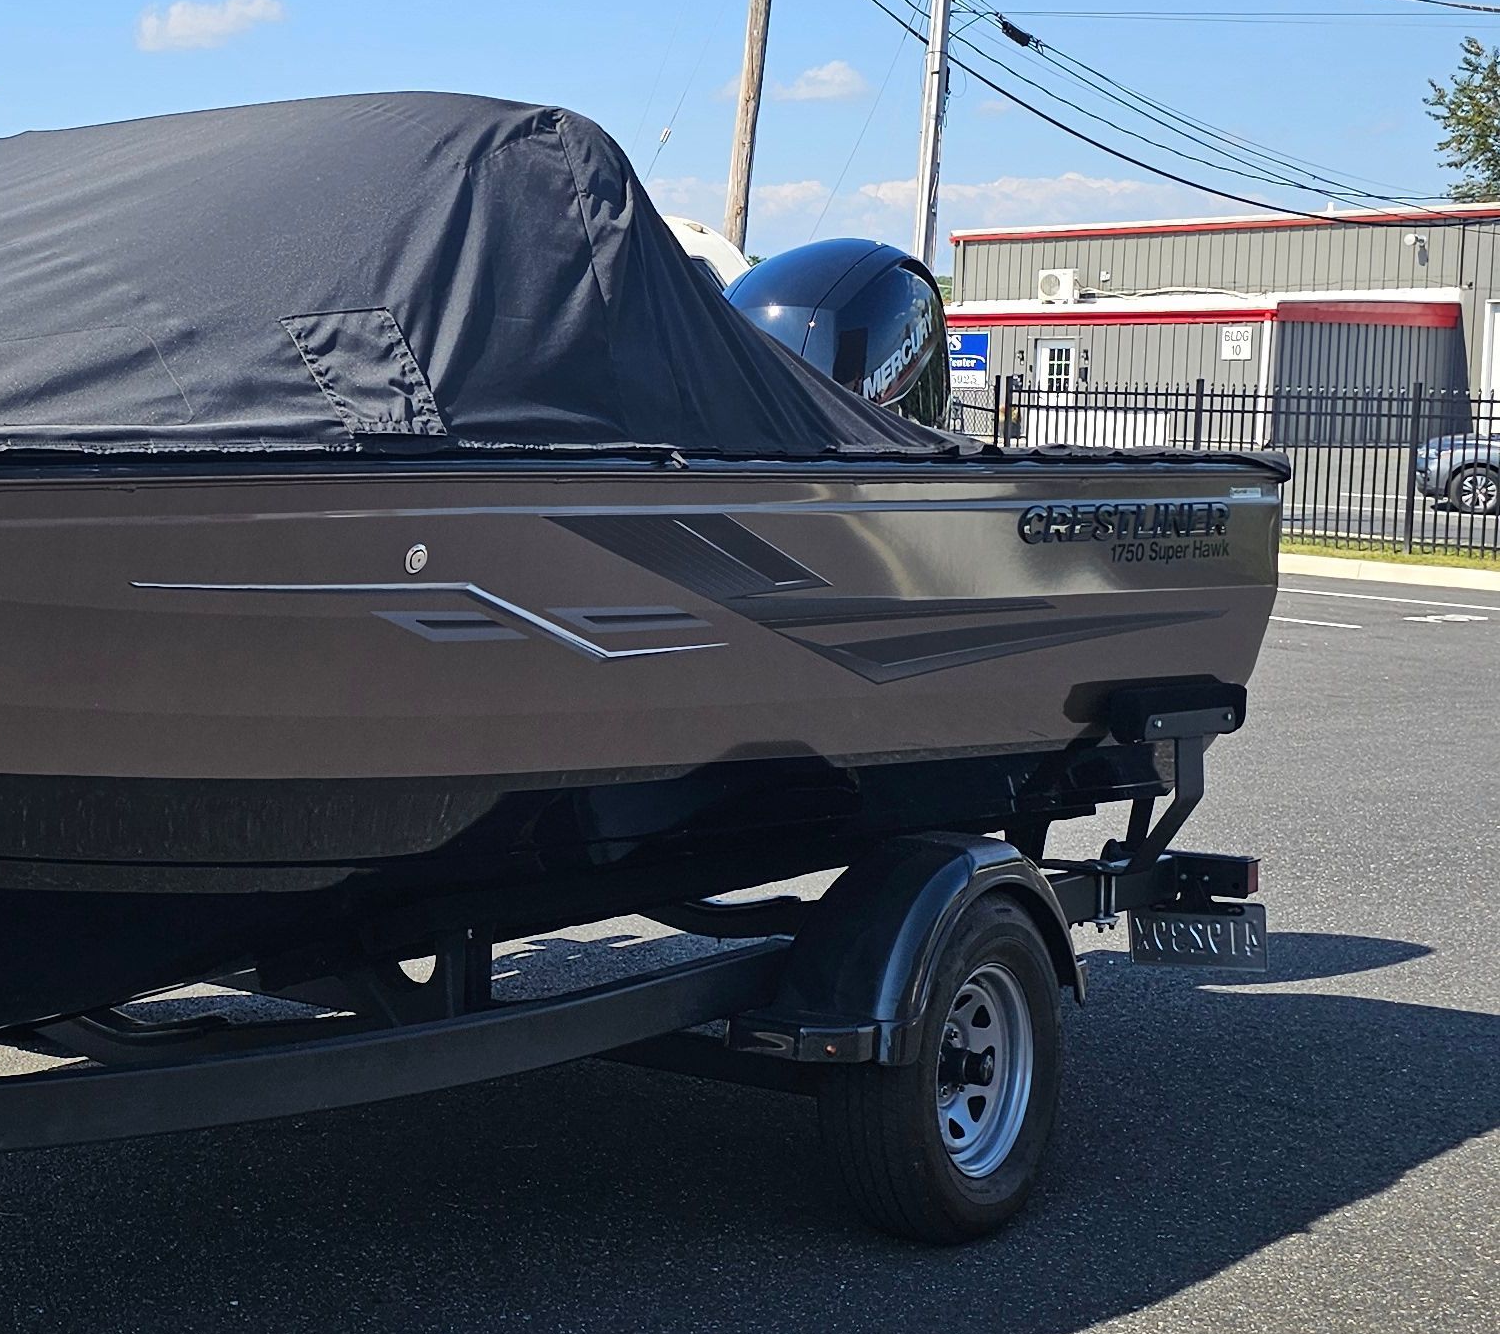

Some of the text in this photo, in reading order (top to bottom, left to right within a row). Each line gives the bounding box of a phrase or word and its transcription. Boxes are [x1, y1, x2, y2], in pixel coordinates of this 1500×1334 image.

[1225, 331, 1249, 341] BLDG
[863, 305, 932, 400] MERCURY
[1232, 345, 1241, 355] 10
[1018, 501, 1231, 545] CRESTLINER
[1111, 540, 1229, 564] 1750 Super Hawk
